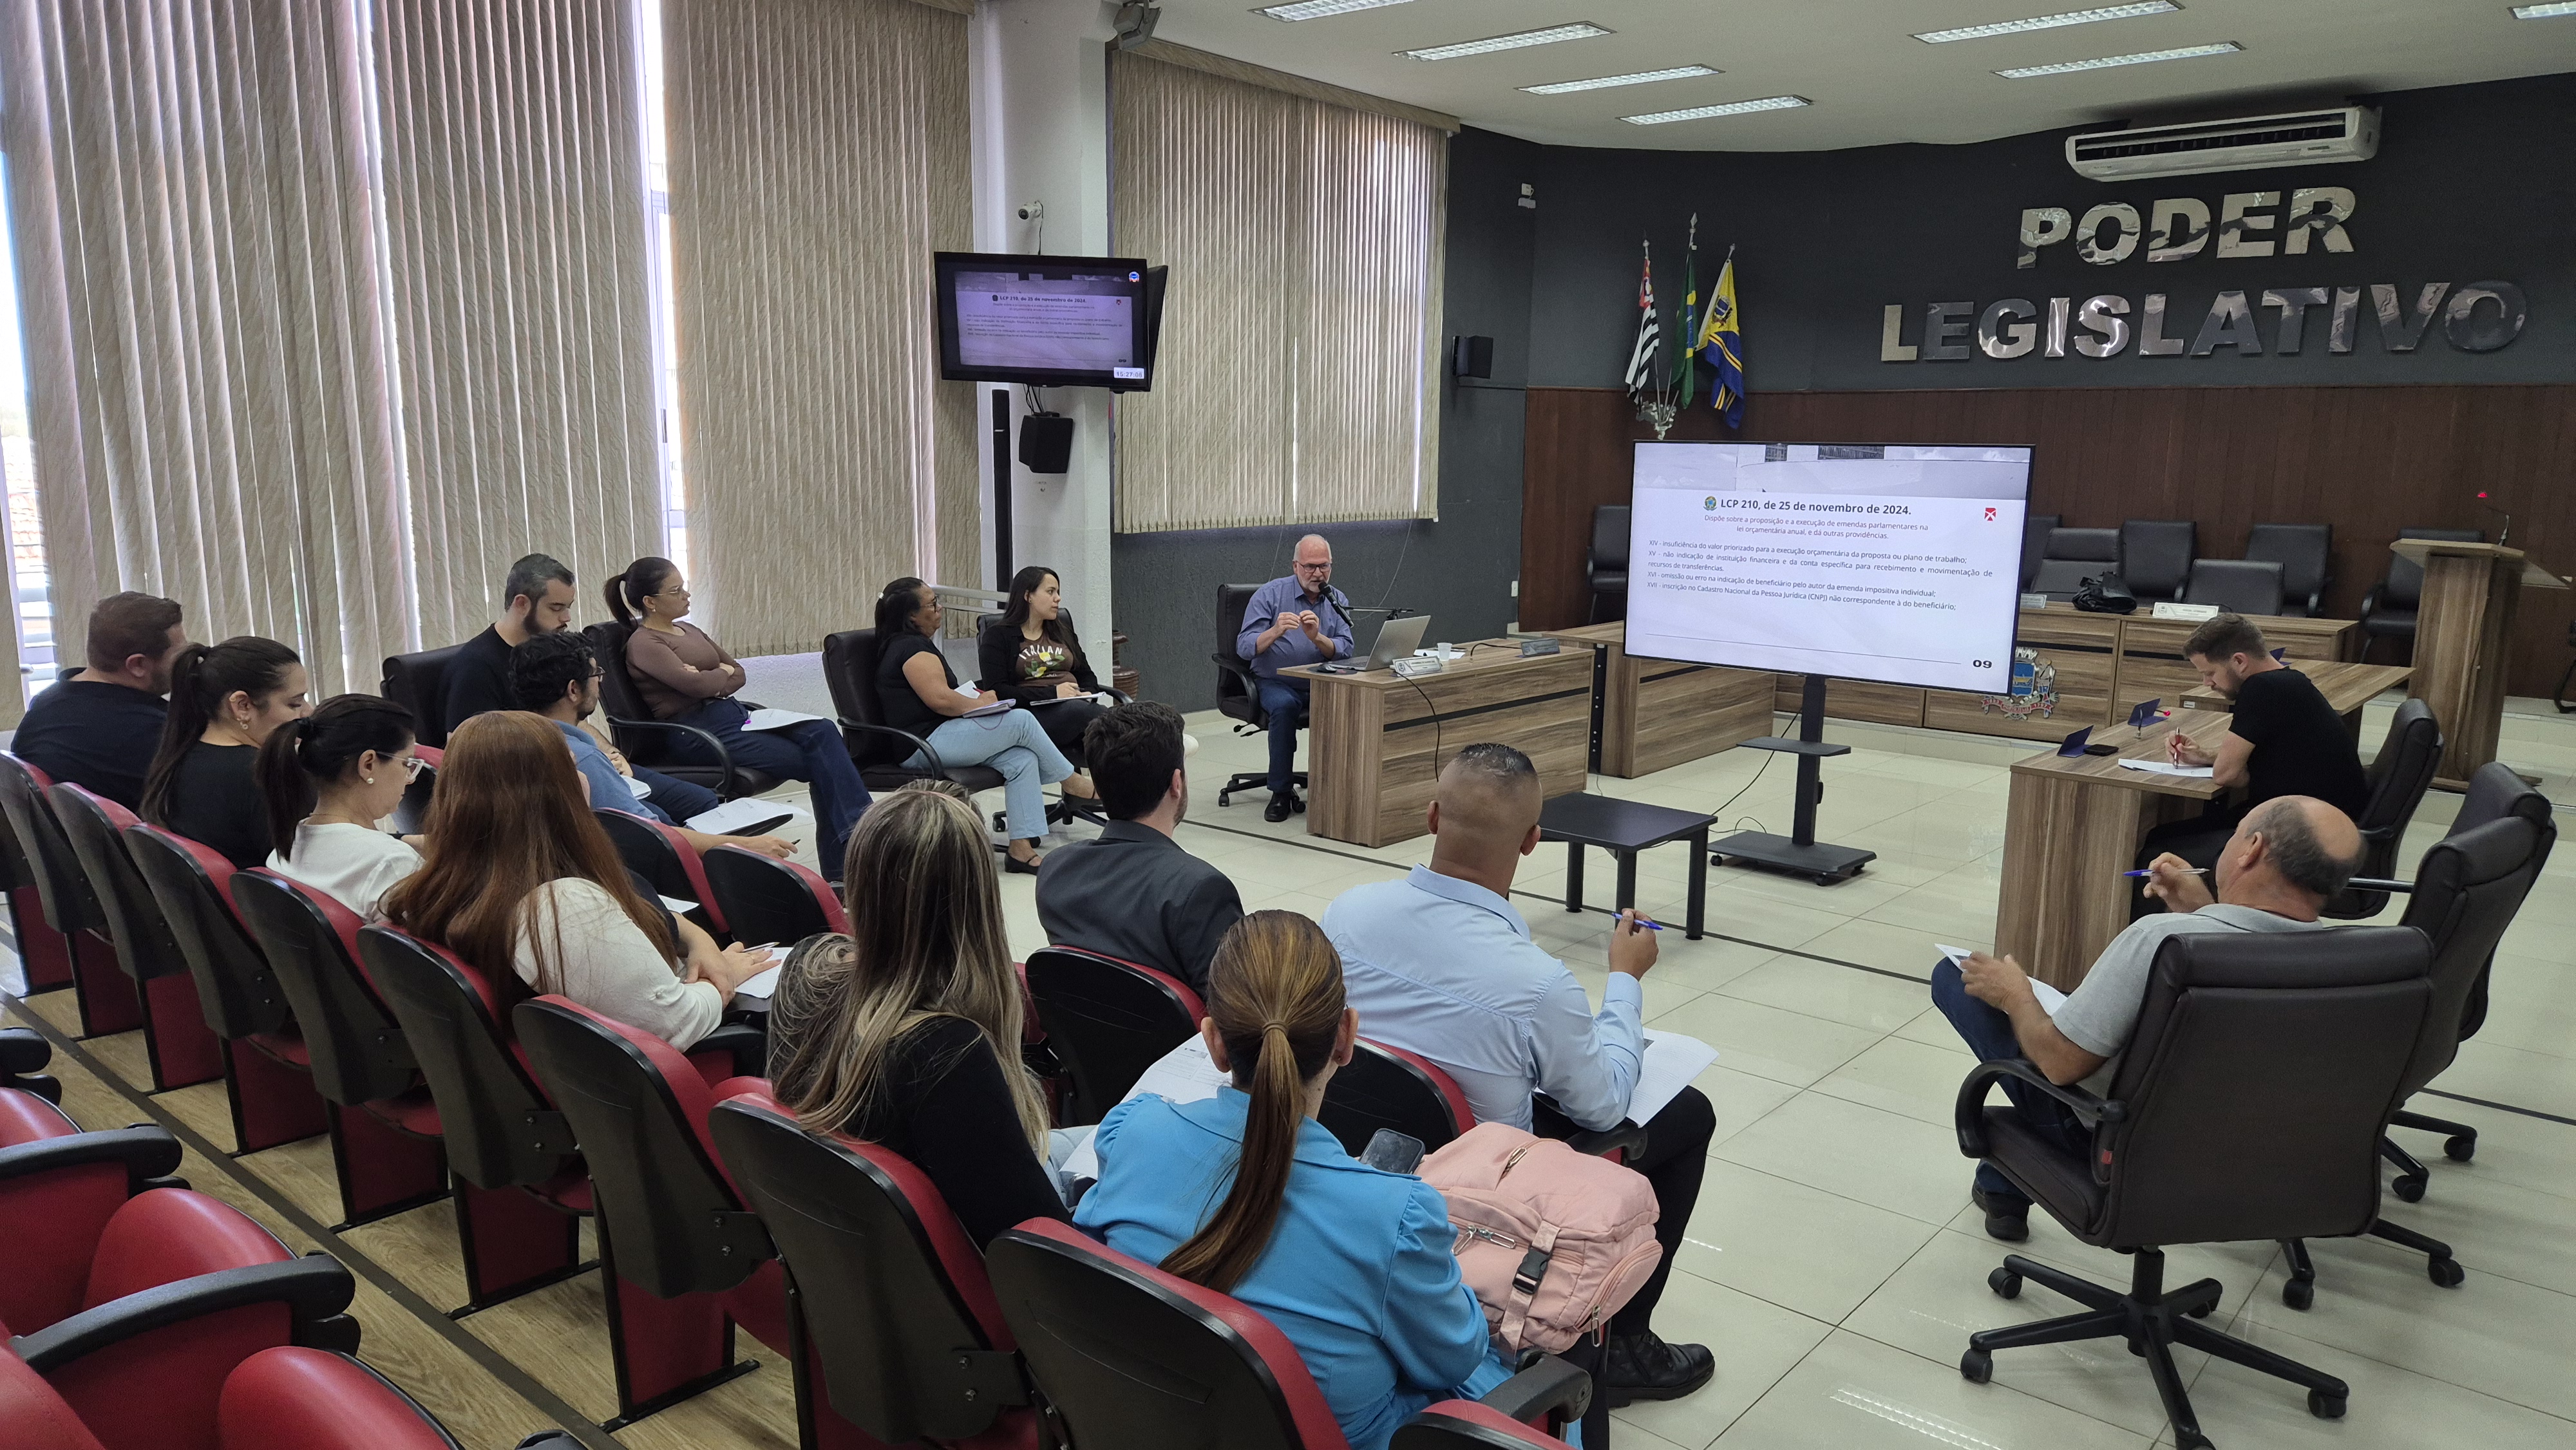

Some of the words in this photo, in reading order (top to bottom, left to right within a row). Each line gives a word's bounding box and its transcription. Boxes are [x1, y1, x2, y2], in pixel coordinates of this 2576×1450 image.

[2016, 186, 2356, 269] PODER
[1881, 280, 2527, 361] LEGISLATIVO
[1721, 499, 1739, 508] LCP
[1741, 500, 1761, 510] 210,
[1764, 500, 1776, 509] de
[1779, 501, 1790, 510] 25
[1793, 501, 1806, 511] de
[1809, 504, 1863, 513] novembro
[1867, 504, 1880, 513] de
[1882, 505, 1911, 515] 2024.
[1927, 568, 1980, 577] movimentação
[1717, 576, 1745, 585] indicação
[1901, 588, 1936, 597] individual;
[1808, 593, 1827, 602] (CNPJ)
[1913, 601, 1956, 611] beneficiário;
[1018, 644, 1062, 660] ITALIAN
[1973, 660, 1992, 669] 09
